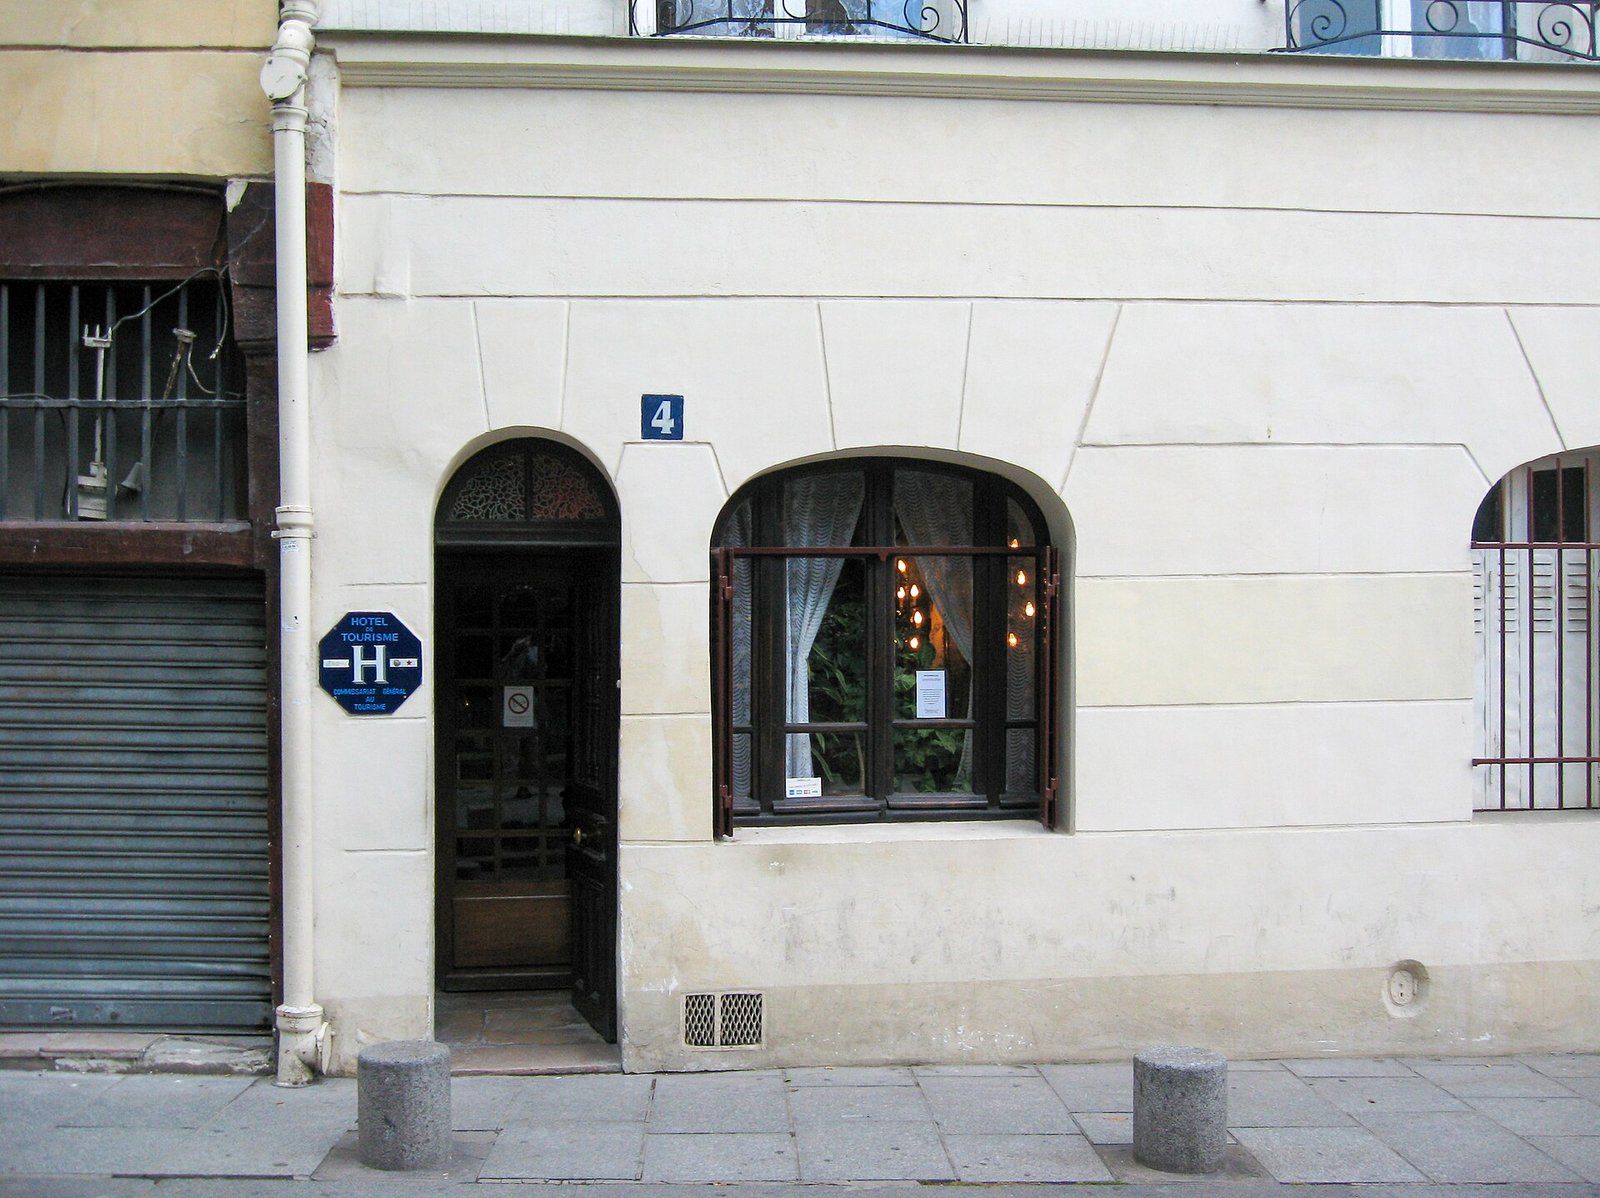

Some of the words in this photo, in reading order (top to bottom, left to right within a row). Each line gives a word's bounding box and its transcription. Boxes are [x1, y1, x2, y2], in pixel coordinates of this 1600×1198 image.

[651, 400, 674, 434] 4
[351, 617, 388, 626] HOTEL
[341, 633, 399, 641] TOURISME
[351, 645, 389, 684] H
